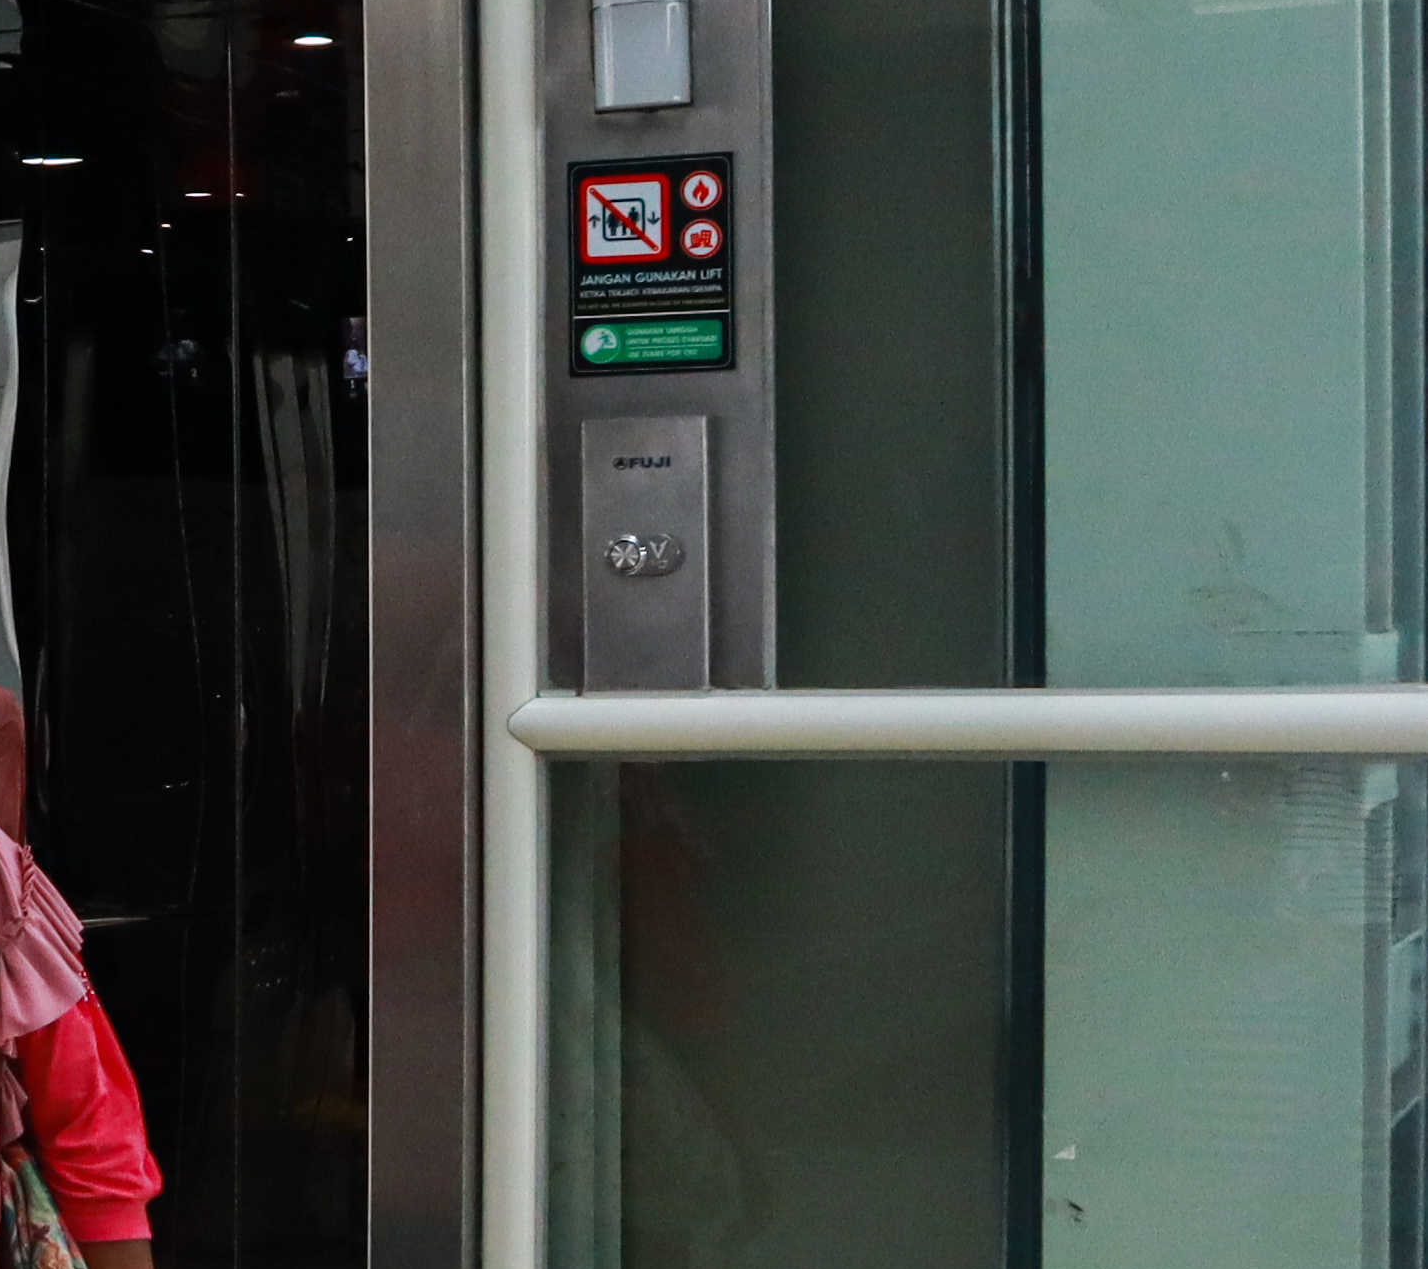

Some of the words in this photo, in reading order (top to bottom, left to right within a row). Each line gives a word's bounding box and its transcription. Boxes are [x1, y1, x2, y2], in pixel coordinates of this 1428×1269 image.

[580, 273, 631, 286] JANGAN
[635, 270, 697, 284] GUNAKAN
[700, 267, 723, 280] LIFT
[629, 456, 671, 468] FUJI
